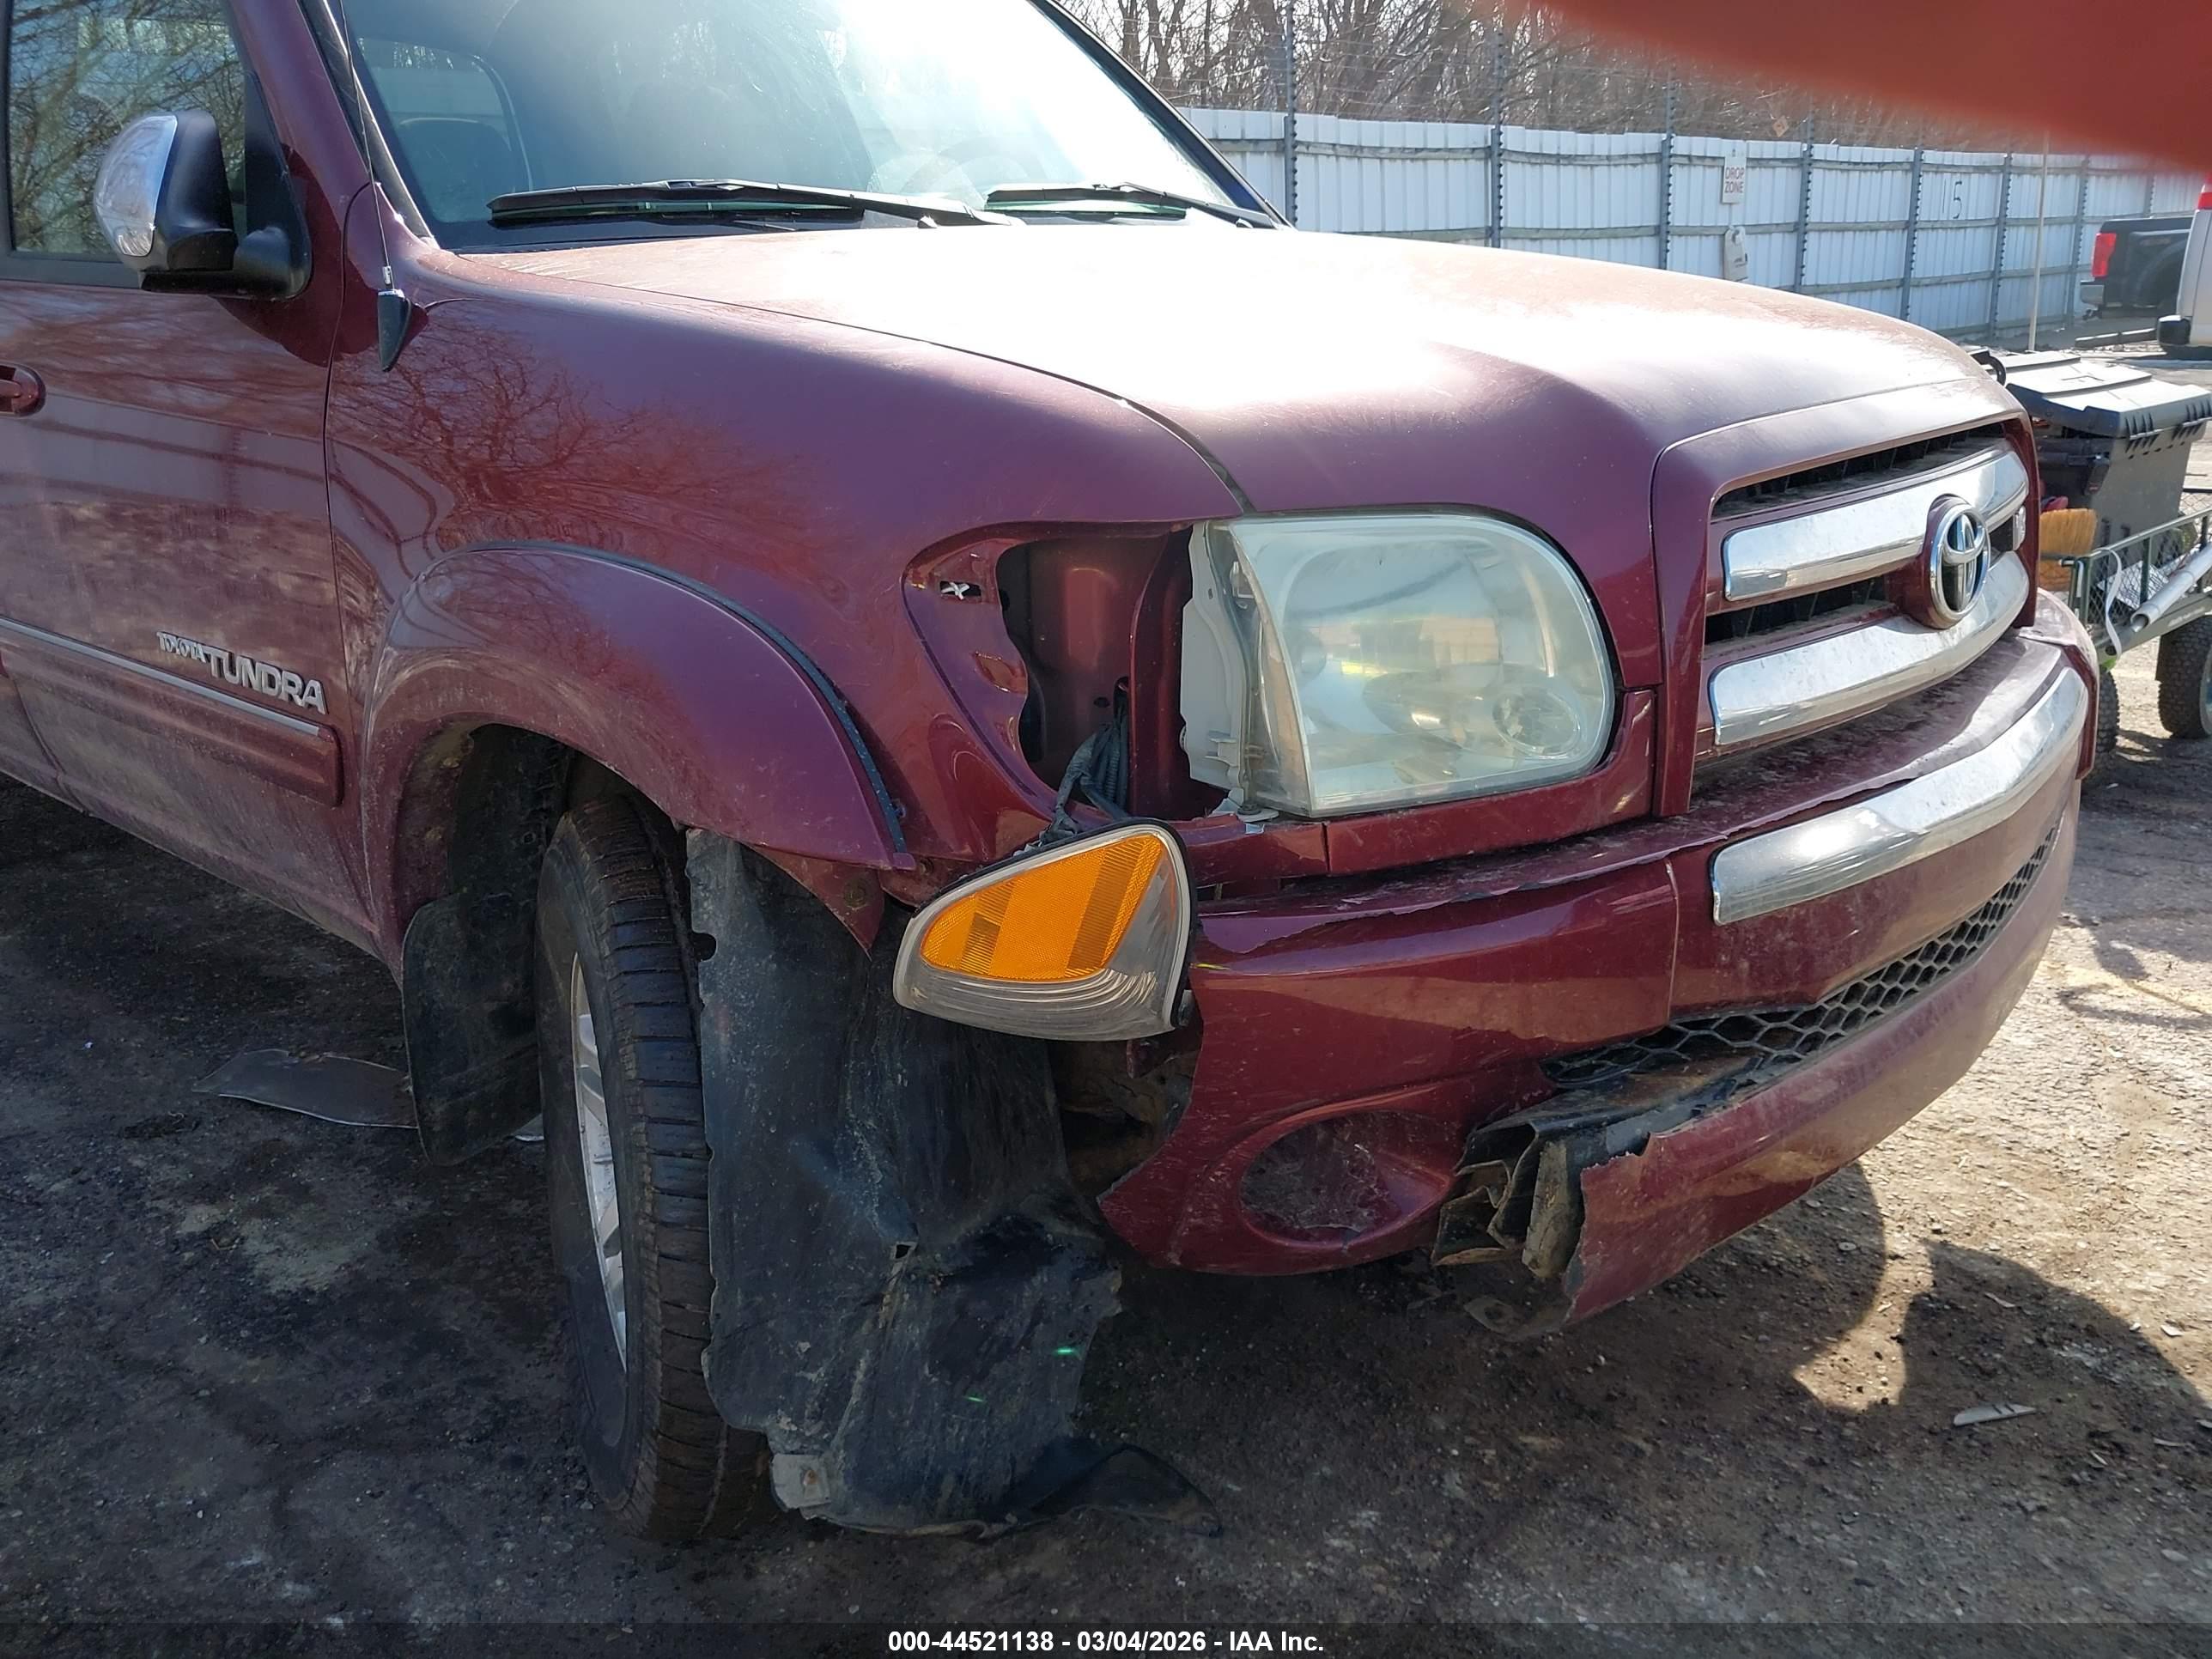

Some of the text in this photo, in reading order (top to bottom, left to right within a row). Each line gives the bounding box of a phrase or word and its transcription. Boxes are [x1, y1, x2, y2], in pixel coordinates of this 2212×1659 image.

[1725, 167, 1745, 179] DROP
[1724, 181, 1743, 193] ZONE
[156, 631, 327, 715] TOYOTA TUNDRA
